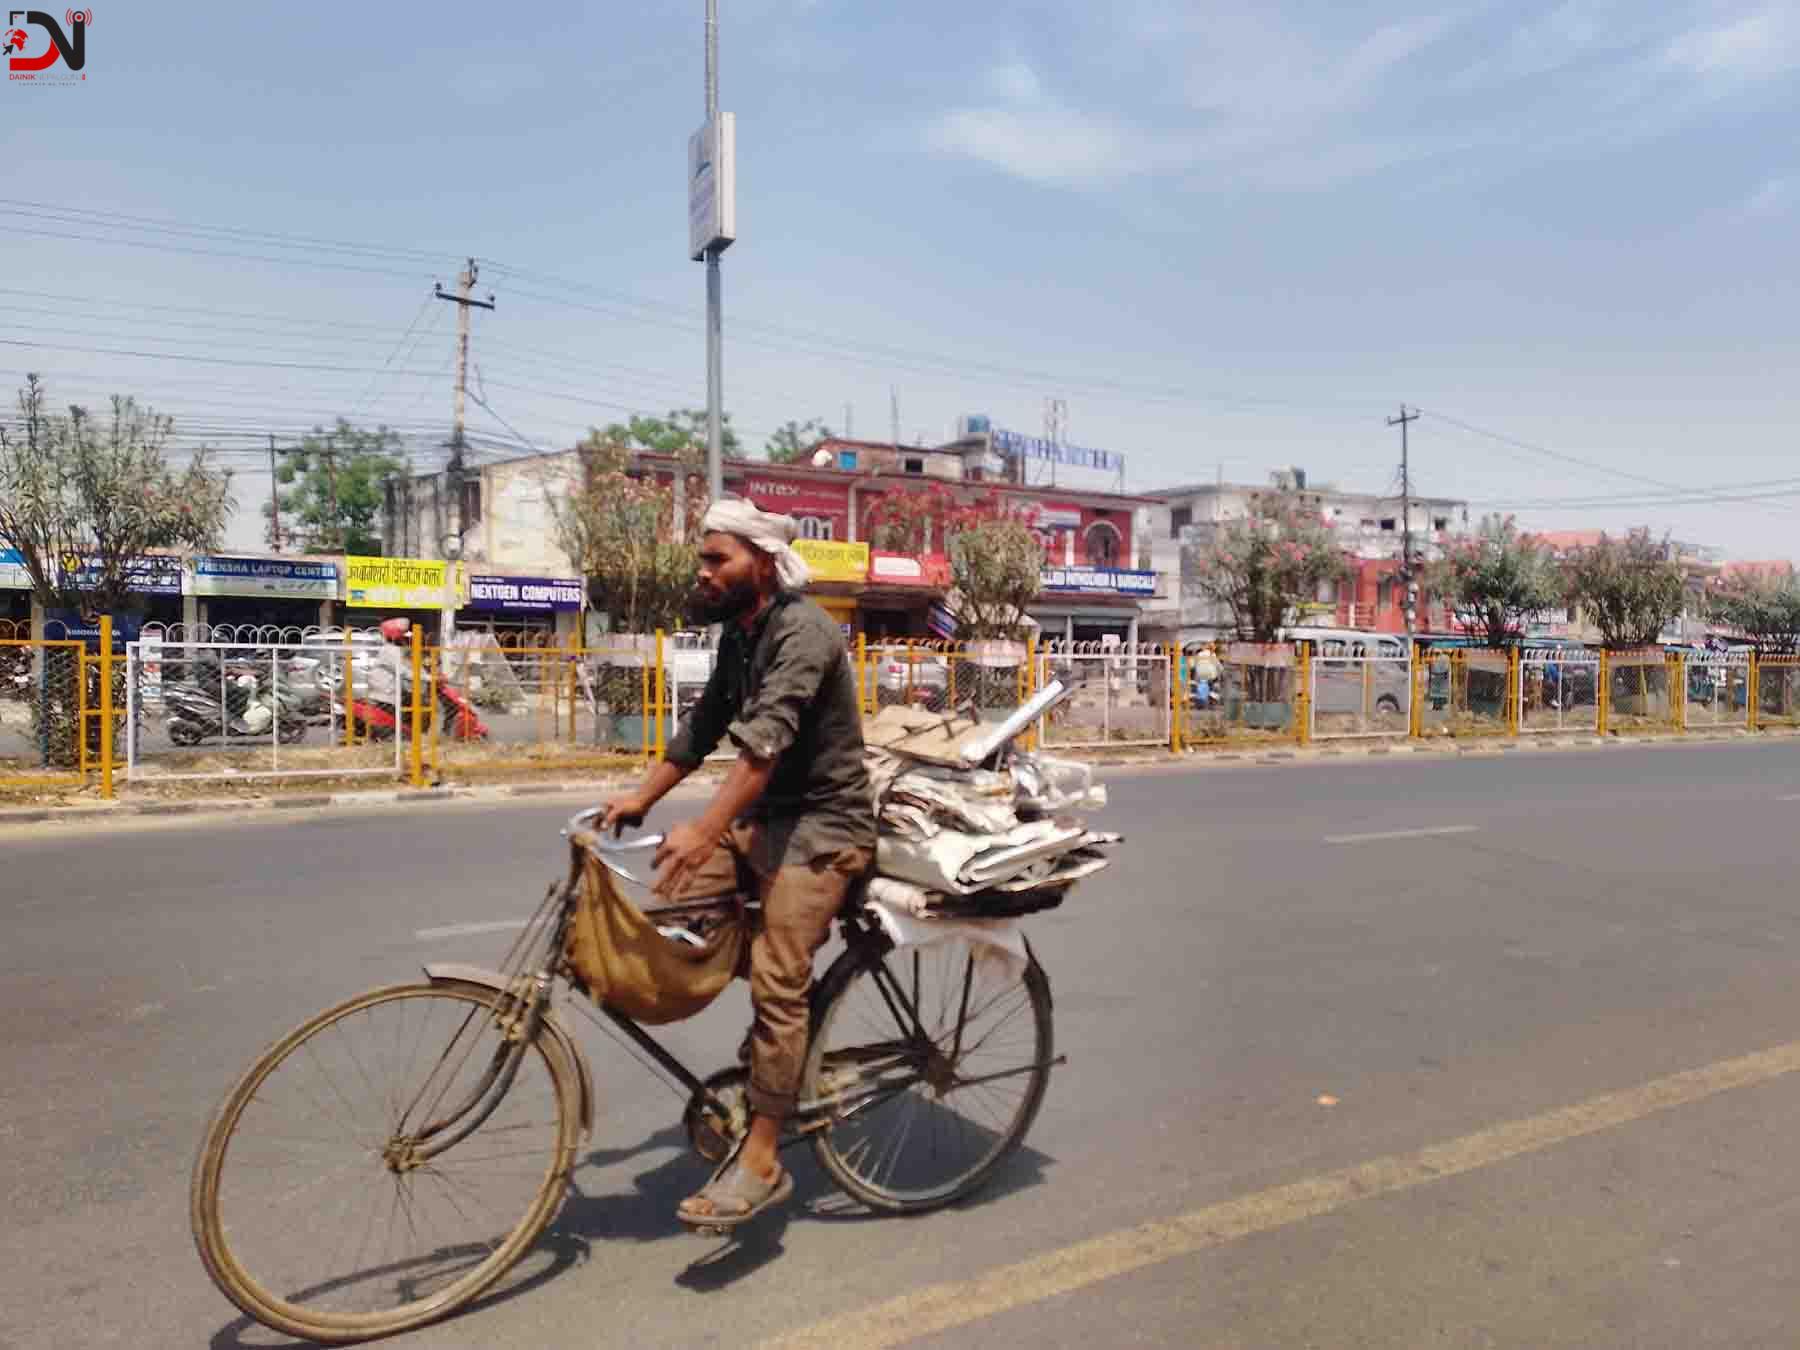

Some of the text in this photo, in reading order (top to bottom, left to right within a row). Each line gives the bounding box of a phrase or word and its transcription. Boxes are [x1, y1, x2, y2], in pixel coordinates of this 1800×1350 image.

[251, 562, 290, 575] LAPTOP
[294, 565, 336, 578] CENTER
[471, 583, 580, 603] NEXTGEN COMPUTERS
